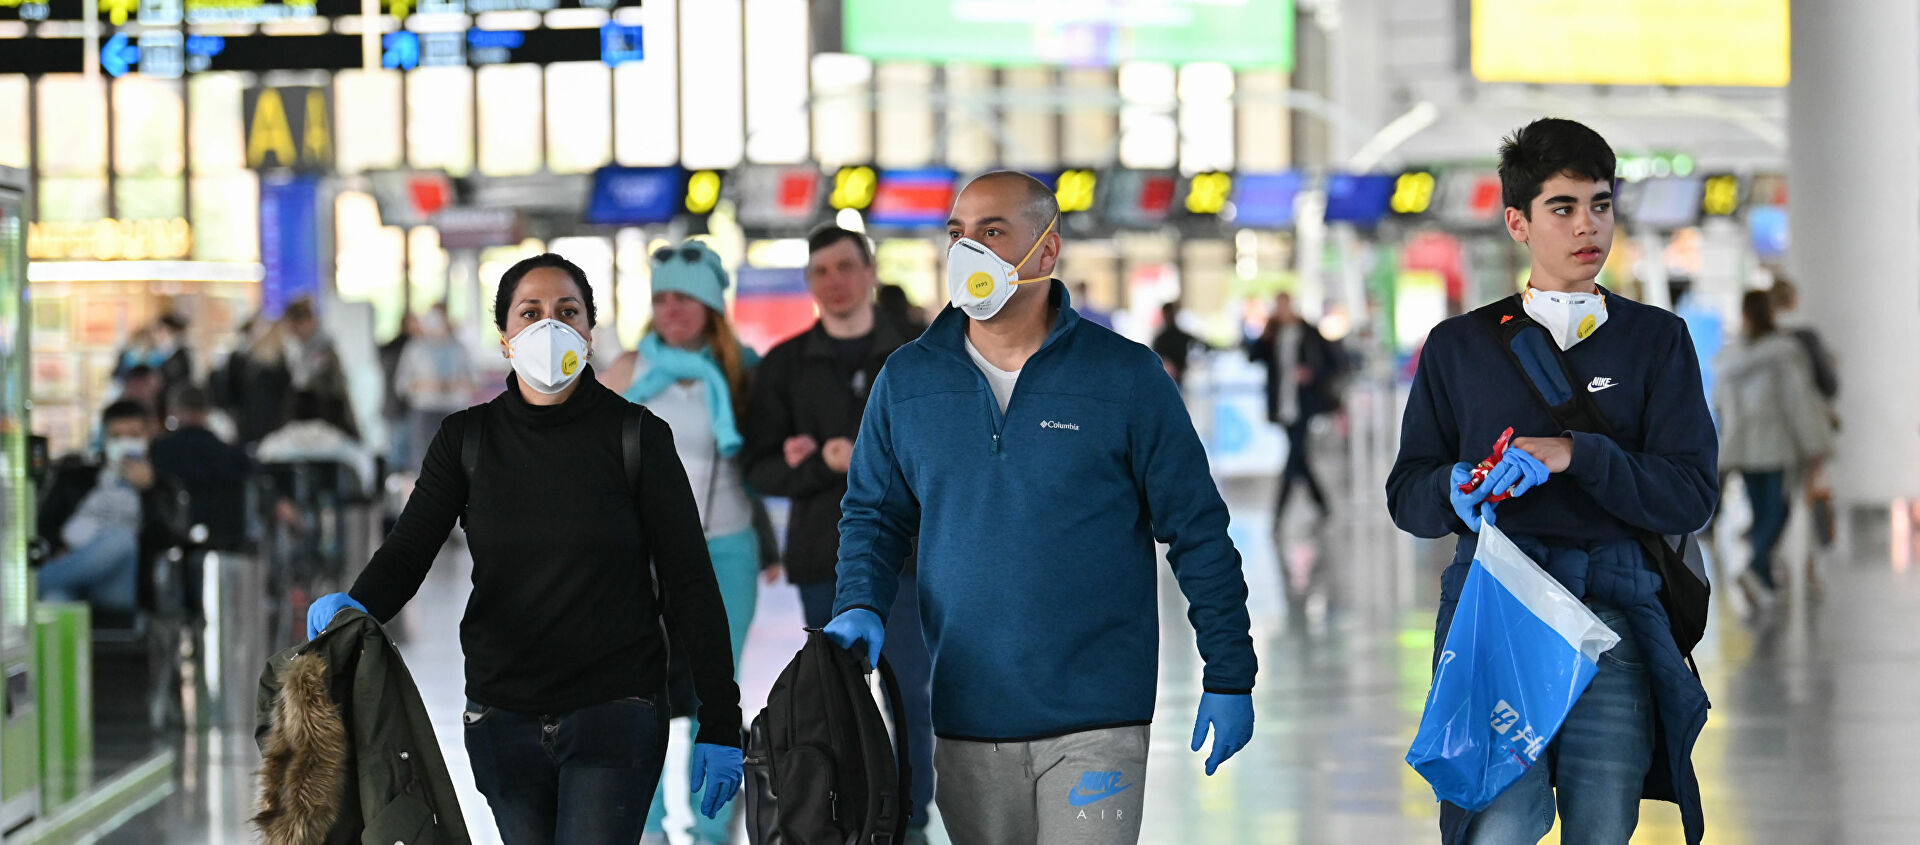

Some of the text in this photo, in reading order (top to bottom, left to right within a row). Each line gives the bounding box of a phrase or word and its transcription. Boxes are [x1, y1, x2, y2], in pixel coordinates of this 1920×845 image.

[246, 87, 297, 167] A
[1592, 377, 1612, 387] NIKE
[1047, 420, 1080, 431] Columbia
[1079, 770, 1123, 792] NIKE
[1076, 809, 1123, 821] AIR
